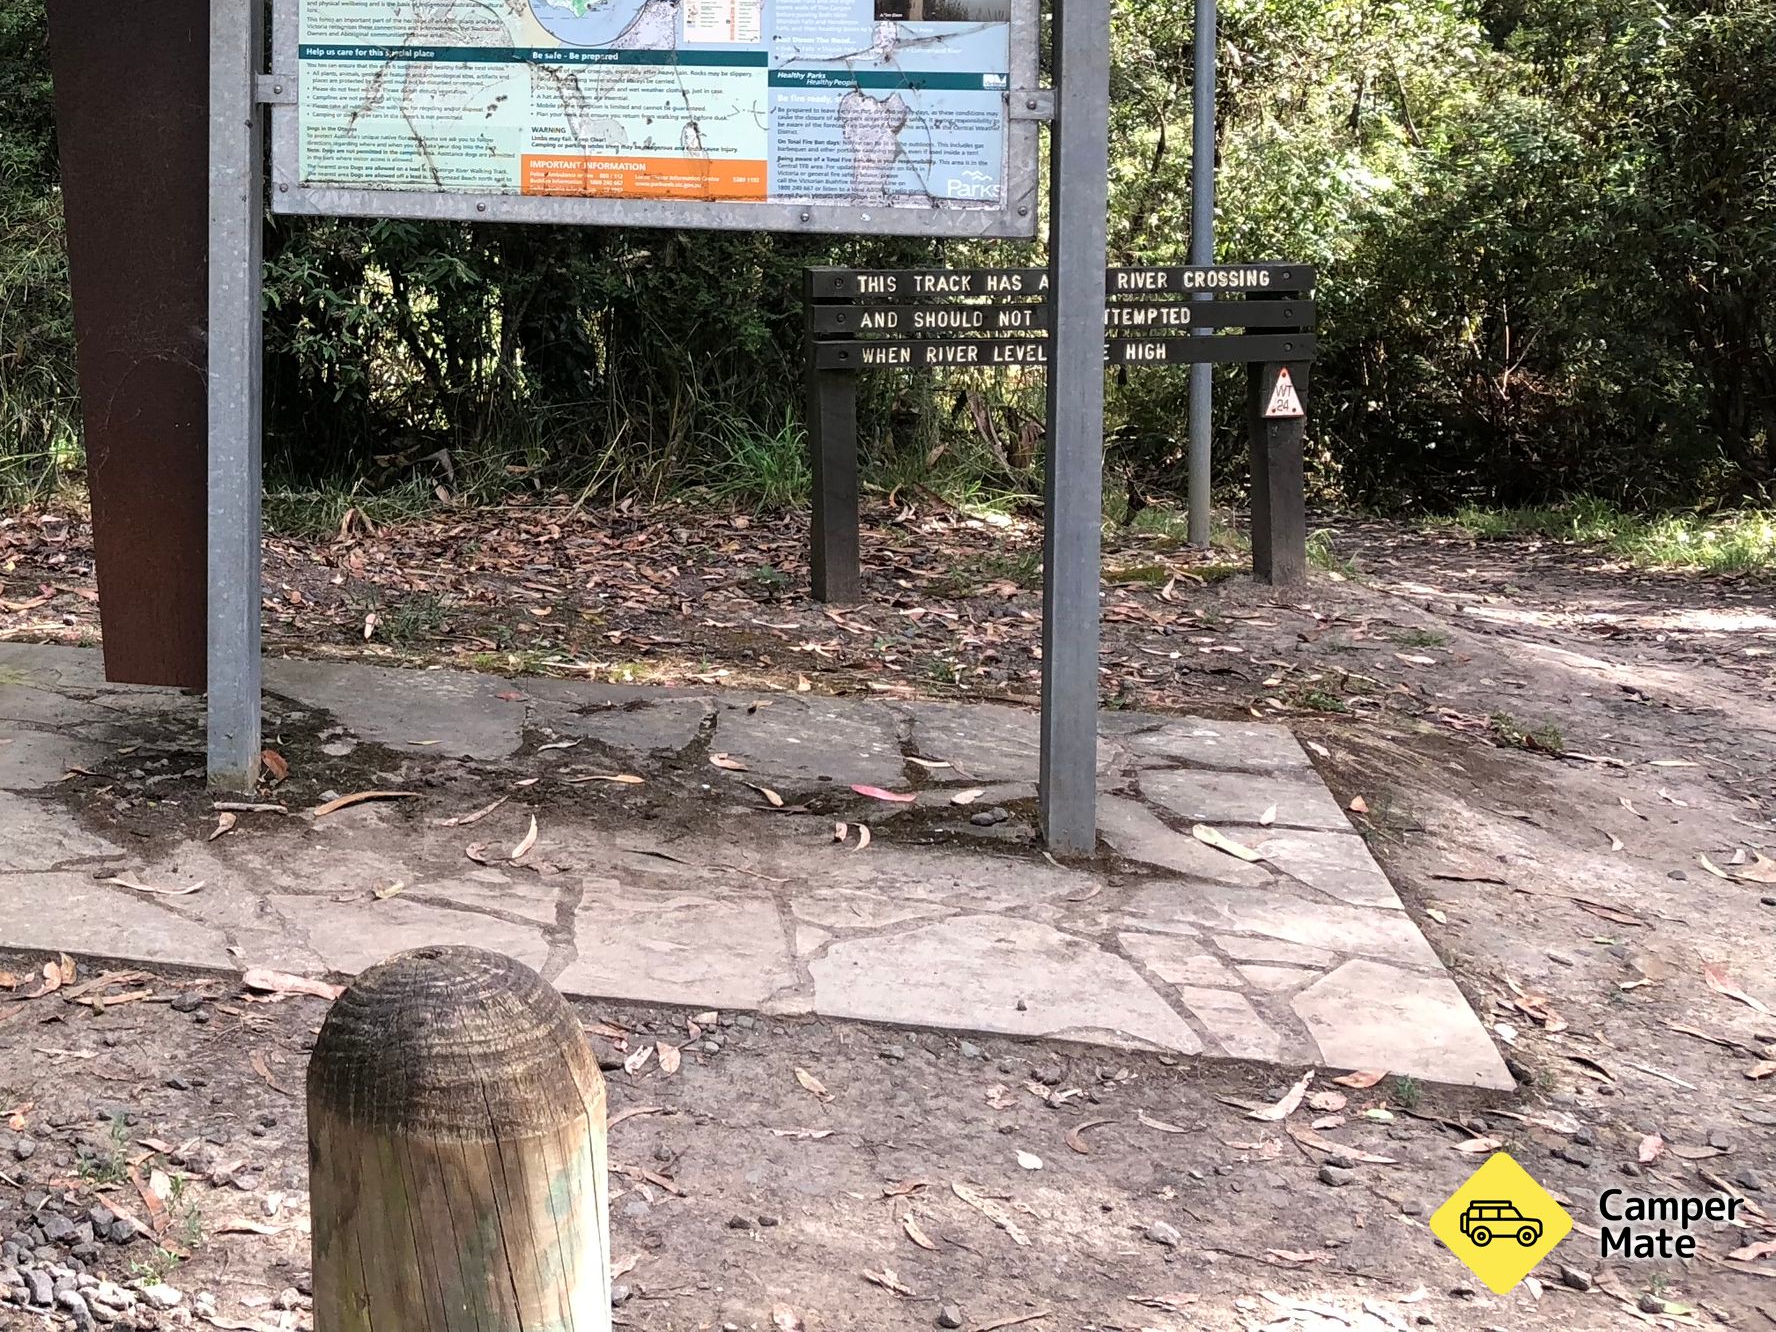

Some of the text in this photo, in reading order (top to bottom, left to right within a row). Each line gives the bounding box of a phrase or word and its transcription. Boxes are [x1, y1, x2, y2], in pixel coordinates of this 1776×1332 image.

[306, 48, 325, 59] Help
[355, 48, 367, 57] for
[369, 48, 384, 57] this
[385, 49, 412, 59] scial
[414, 49, 435, 60] place
[532, 51, 543, 60] Be
[544, 51, 562, 60] safe
[569, 52, 580, 61] Be
[777, 71, 805, 80] Healthy
[807, 79, 833, 87] Healthy
[777, 95, 788, 103] Be
[530, 160, 647, 172] IMPORTANT INFORMATION
[947, 179, 1001, 198] Parks
[857, 269, 1270, 293] THIS TRACK HAS A RIVER CROSSING
[860, 307, 1191, 329] AND SHOULD NOT TTEMPTED
[862, 347, 911, 364] WHEN
[926, 346, 978, 363] RIVER
[993, 345, 1048, 362] LEVEL
[1126, 343, 1166, 360] HIGH
[1275, 385, 1292, 398] WT
[1277, 399, 1290, 411] 24
